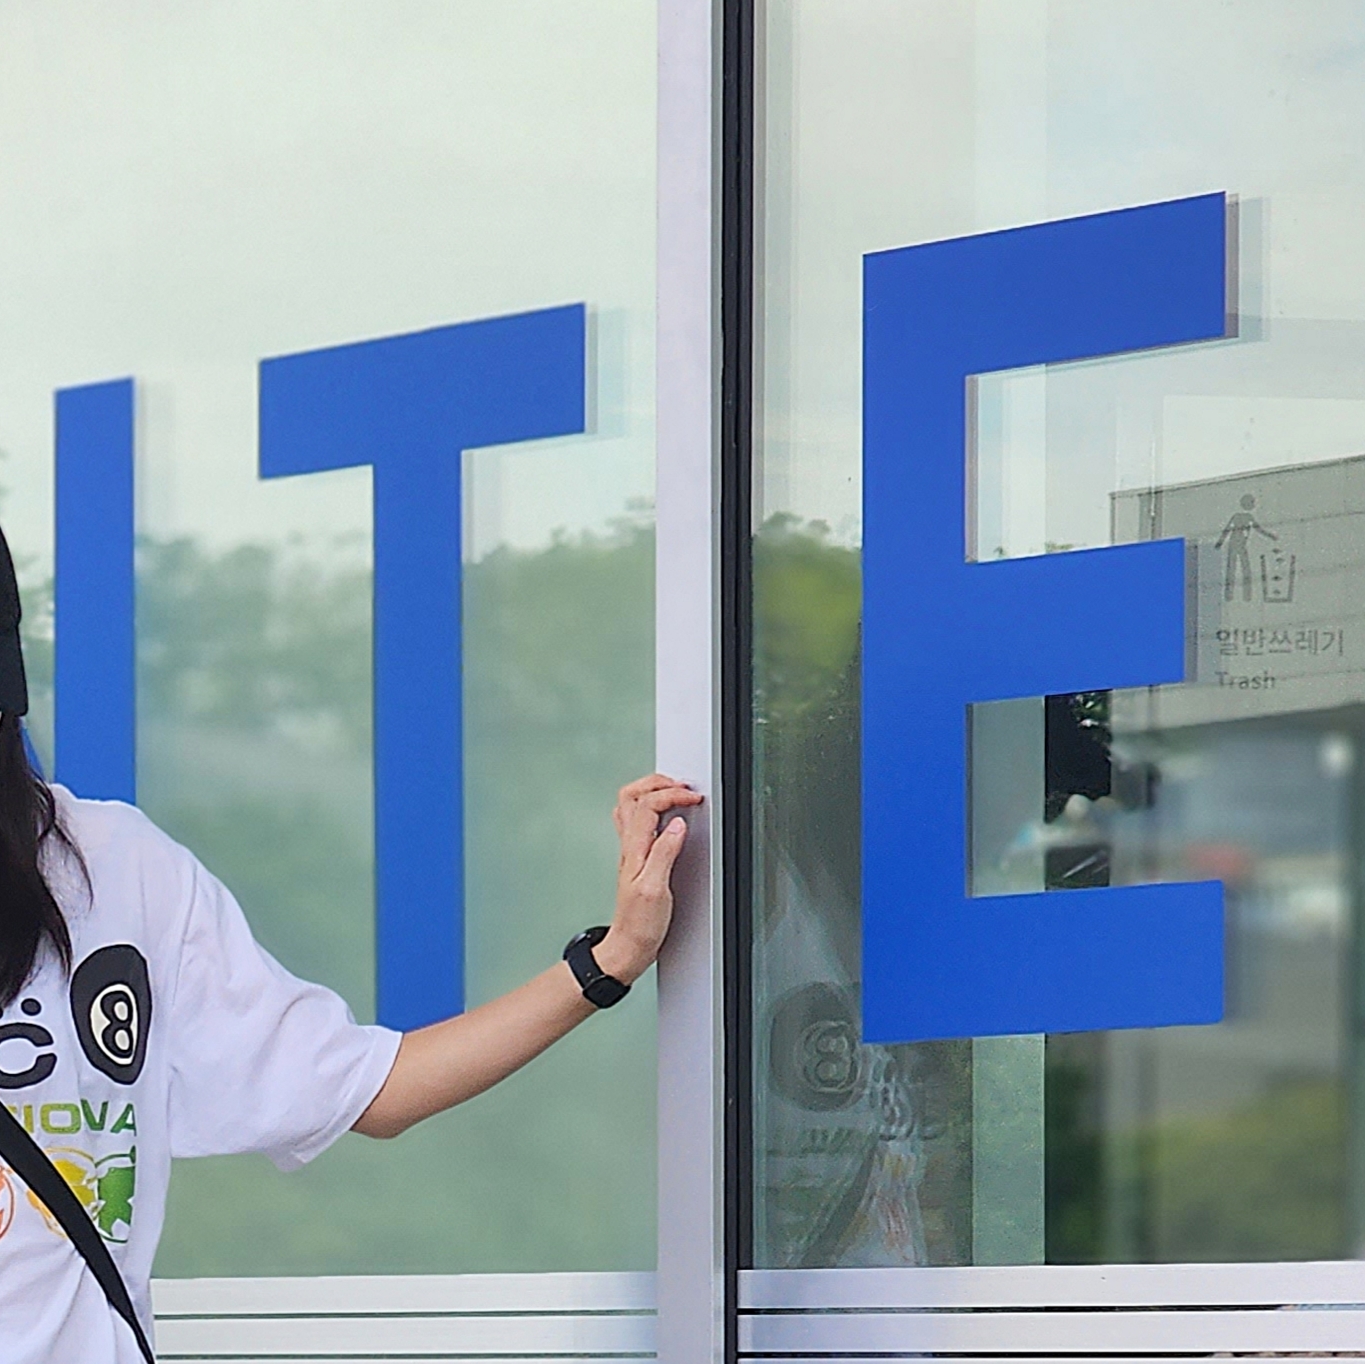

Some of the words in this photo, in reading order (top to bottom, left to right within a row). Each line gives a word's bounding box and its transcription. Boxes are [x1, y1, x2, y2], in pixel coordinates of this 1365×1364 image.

[1215, 629, 1344, 656] 일반쓰레기
[1216, 671, 1276, 690] Trash
[100, 991, 135, 1058] 8
